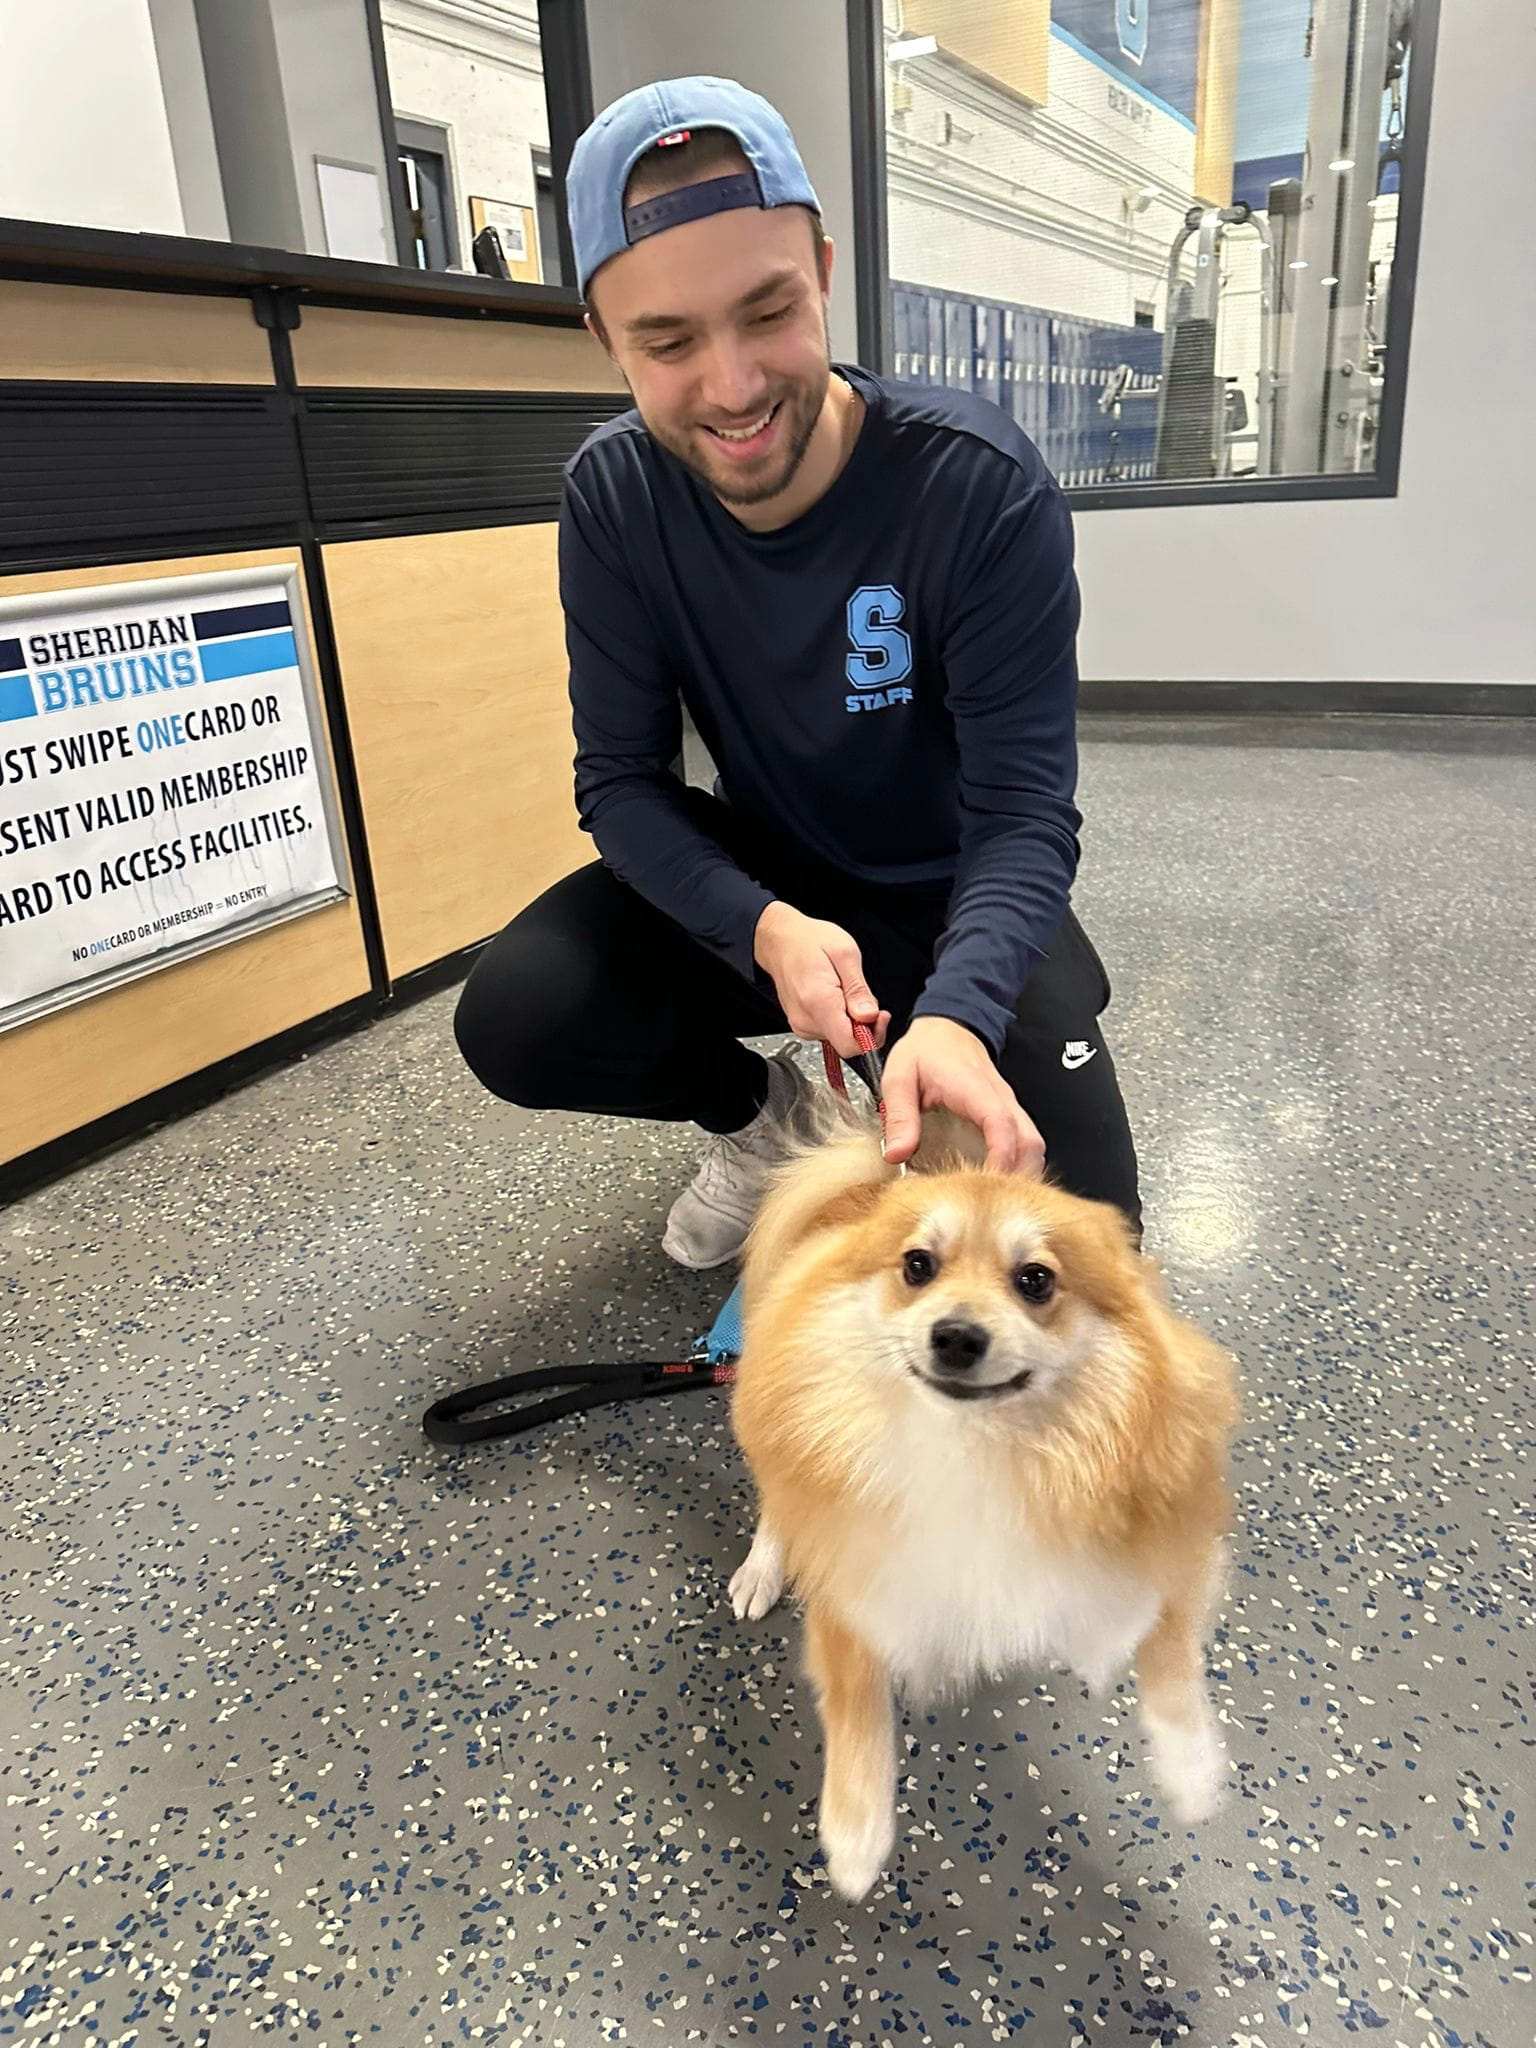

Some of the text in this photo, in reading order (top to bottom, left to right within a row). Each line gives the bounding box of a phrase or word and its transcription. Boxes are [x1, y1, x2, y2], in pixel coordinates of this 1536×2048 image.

[29, 615, 190, 666] SHERIDAN
[845, 585, 913, 689] S
[36, 648, 197, 714] BRUINS
[845, 687, 913, 712] STAFF
[45, 726, 133, 774] SWIPE
[137, 703, 246, 752] ONECARD
[251, 695, 281, 727] OR
[0, 747, 308, 857] SENT VALID MEMBERSHIP
[56, 868, 92, 906] TO
[100, 839, 187, 894] ACCESS
[190, 805, 312, 863] FACILITIES.
[72, 946, 89, 962] NO
[90, 929, 136, 956] ONECARD
[137, 924, 152, 938] OR
[152, 902, 214, 933] MEMBERSHIP
[224, 893, 239, 908] NO
[240, 884, 269, 903] ENTRY
